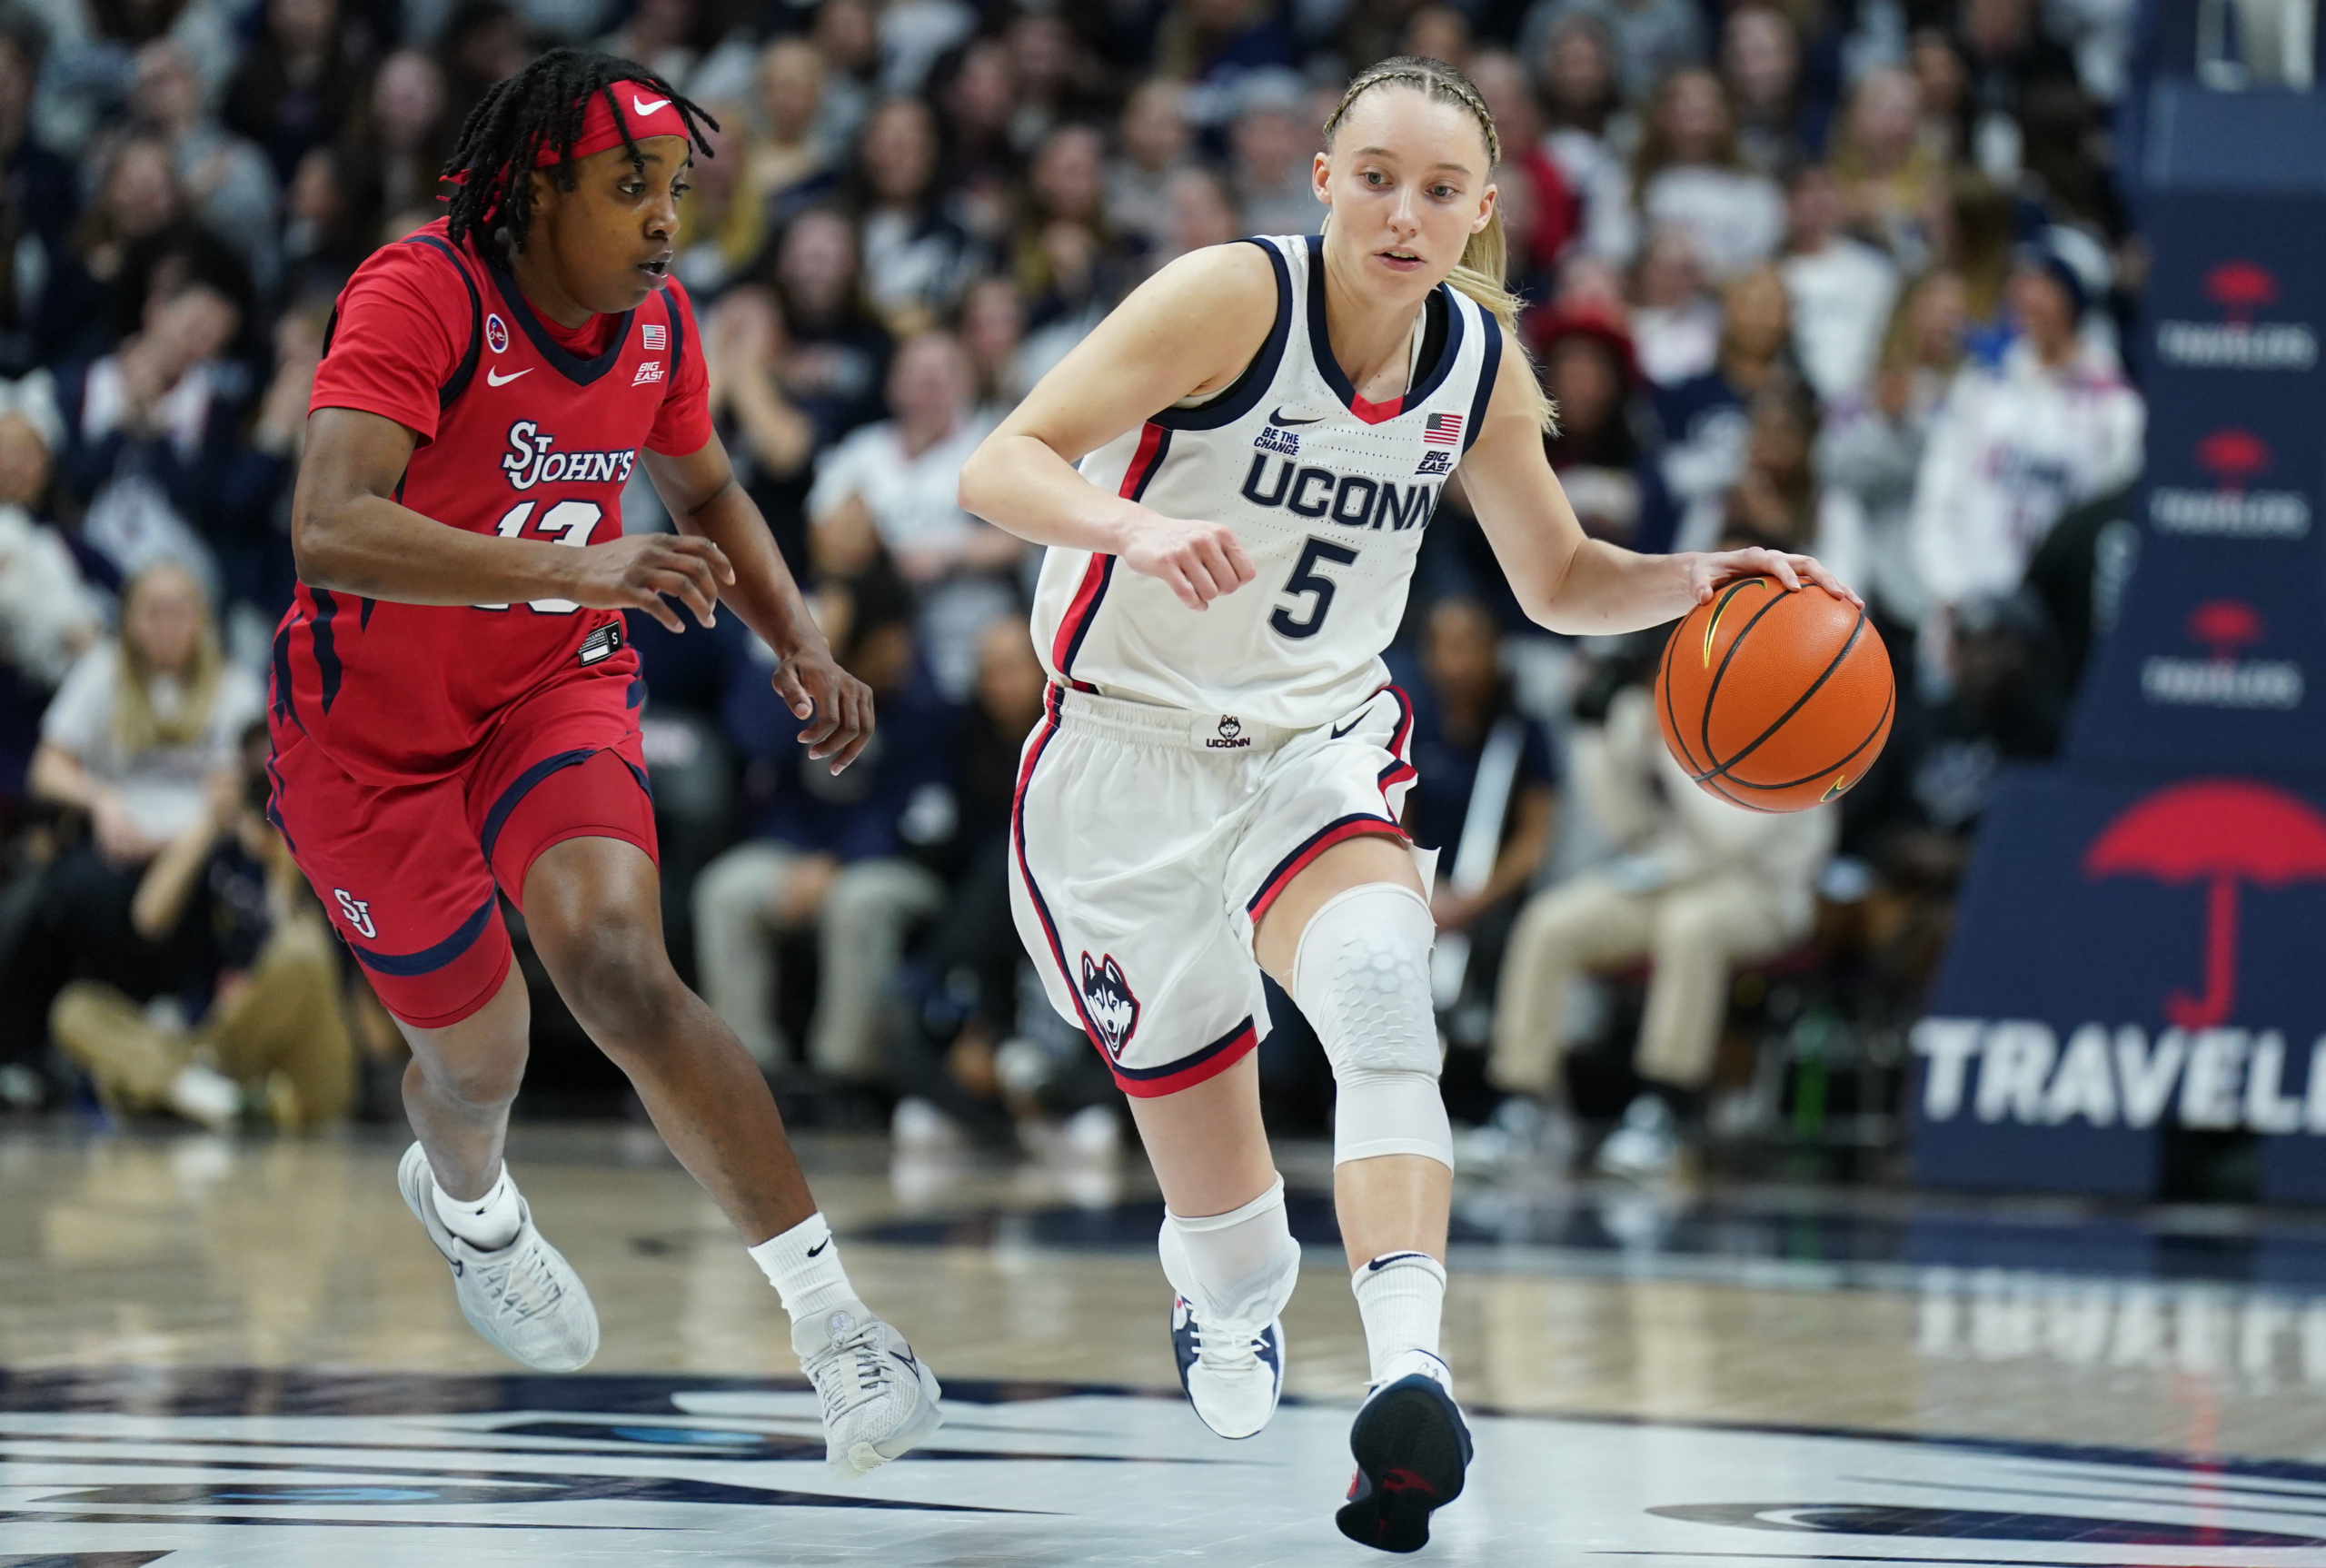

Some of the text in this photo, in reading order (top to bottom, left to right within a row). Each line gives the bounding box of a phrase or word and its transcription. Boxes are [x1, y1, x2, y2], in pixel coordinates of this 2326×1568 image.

[638, 362, 661, 372] BIG
[634, 371, 665, 382] EAST
[1261, 426, 1300, 445] BE THE
[1253, 436, 1300, 456] CHANGE
[1424, 451, 1450, 462] BIG
[1417, 461, 1453, 472] EAST
[1239, 450, 1444, 533] UCONN
[1267, 533, 1361, 640] 5
[611, 632, 619, 645] S
[1206, 737, 1251, 749] UCONN
[1908, 1015, 2326, 1136] TRAVEL
